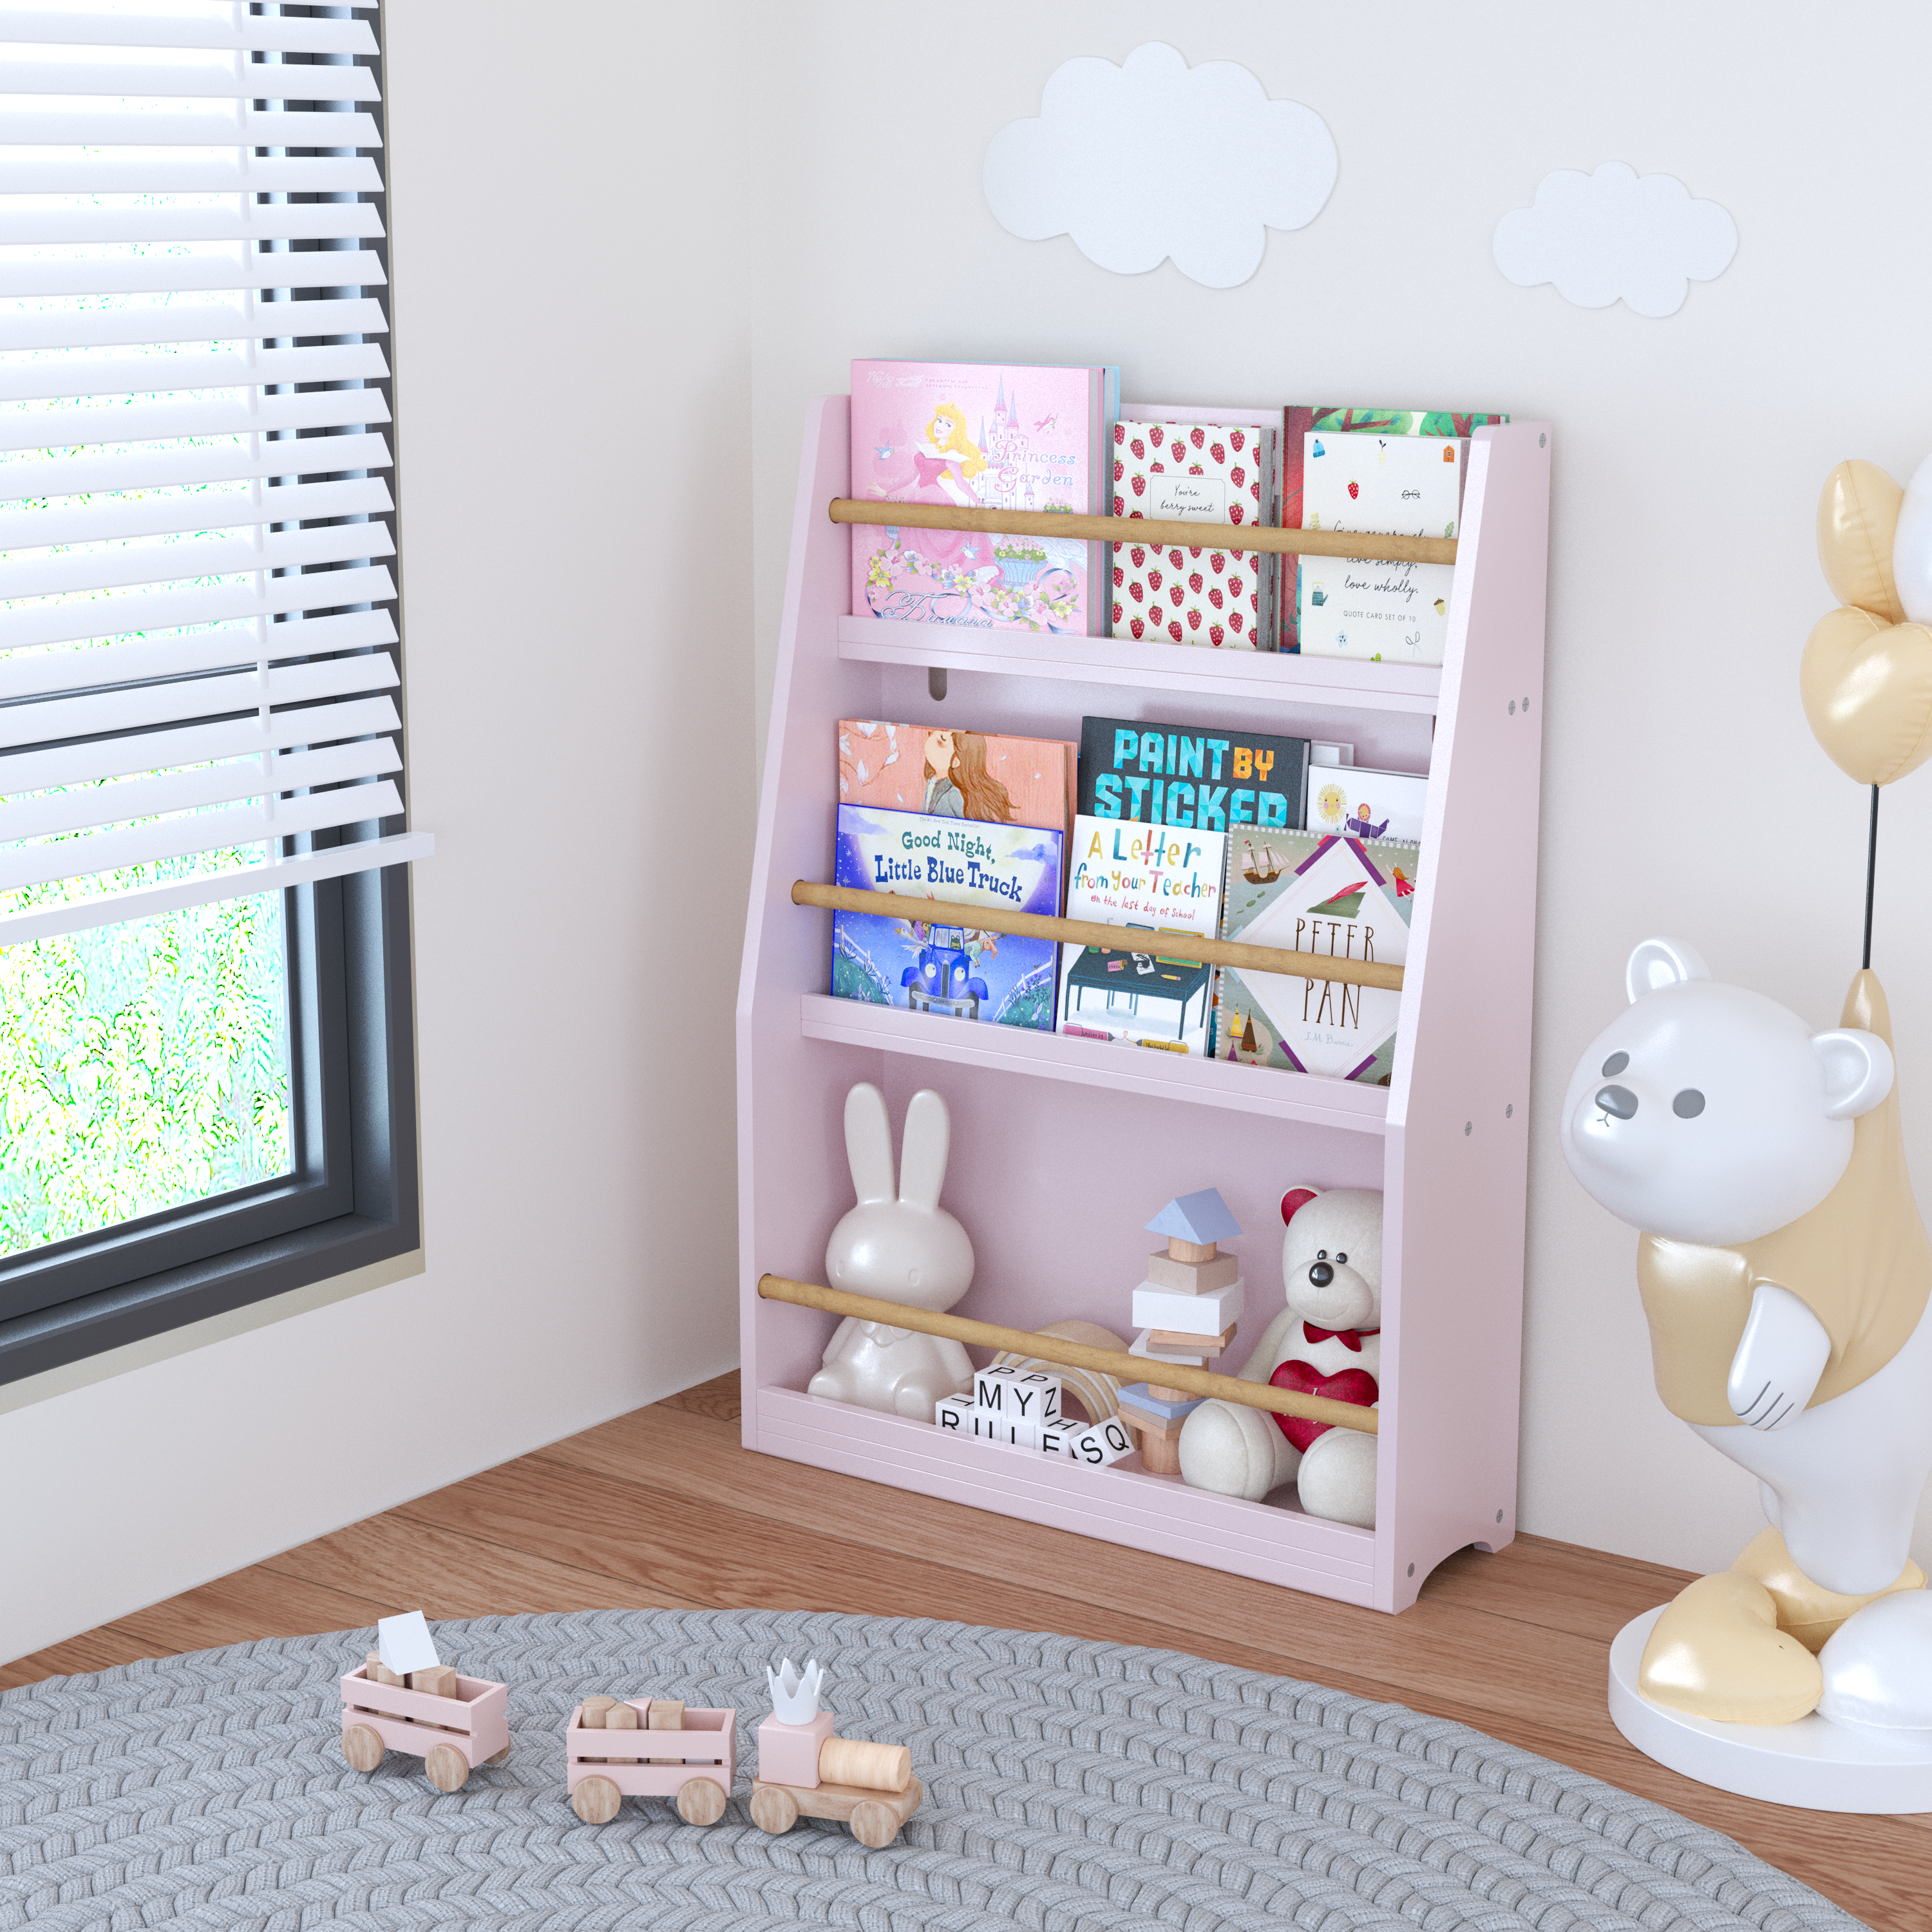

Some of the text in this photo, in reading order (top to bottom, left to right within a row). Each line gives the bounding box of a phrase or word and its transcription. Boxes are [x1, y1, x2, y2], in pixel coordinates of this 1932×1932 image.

[992, 439, 1076, 464] Princess
[994, 466, 1074, 493] Garden
[1174, 484, 1200, 497] You're
[1160, 499, 1215, 516] berry sweet
[1345, 574, 1418, 603] love wholly.
[1343, 610, 1364, 618] QUOTE
[1113, 728, 1274, 782] PAINT BY
[902, 830, 996, 865] Good Night,
[1088, 828, 1201, 868] A Letter
[875, 855, 1023, 903] Little Blue Truck
[1074, 862, 1108, 889] from
[1149, 870, 1217, 898] Teacher
[1090, 895, 1101, 903] on
[1104, 896, 1117, 907] the
[1121, 896, 1139, 911] last
[1143, 902, 1157, 917] day
[1160, 907, 1170, 918] of
[1296, 918, 1374, 962] PETER
[1302, 978, 1361, 1029] PAN
[1325, 1034, 1353, 1047] Barrie
[979, 1380, 1034, 1417] MY
